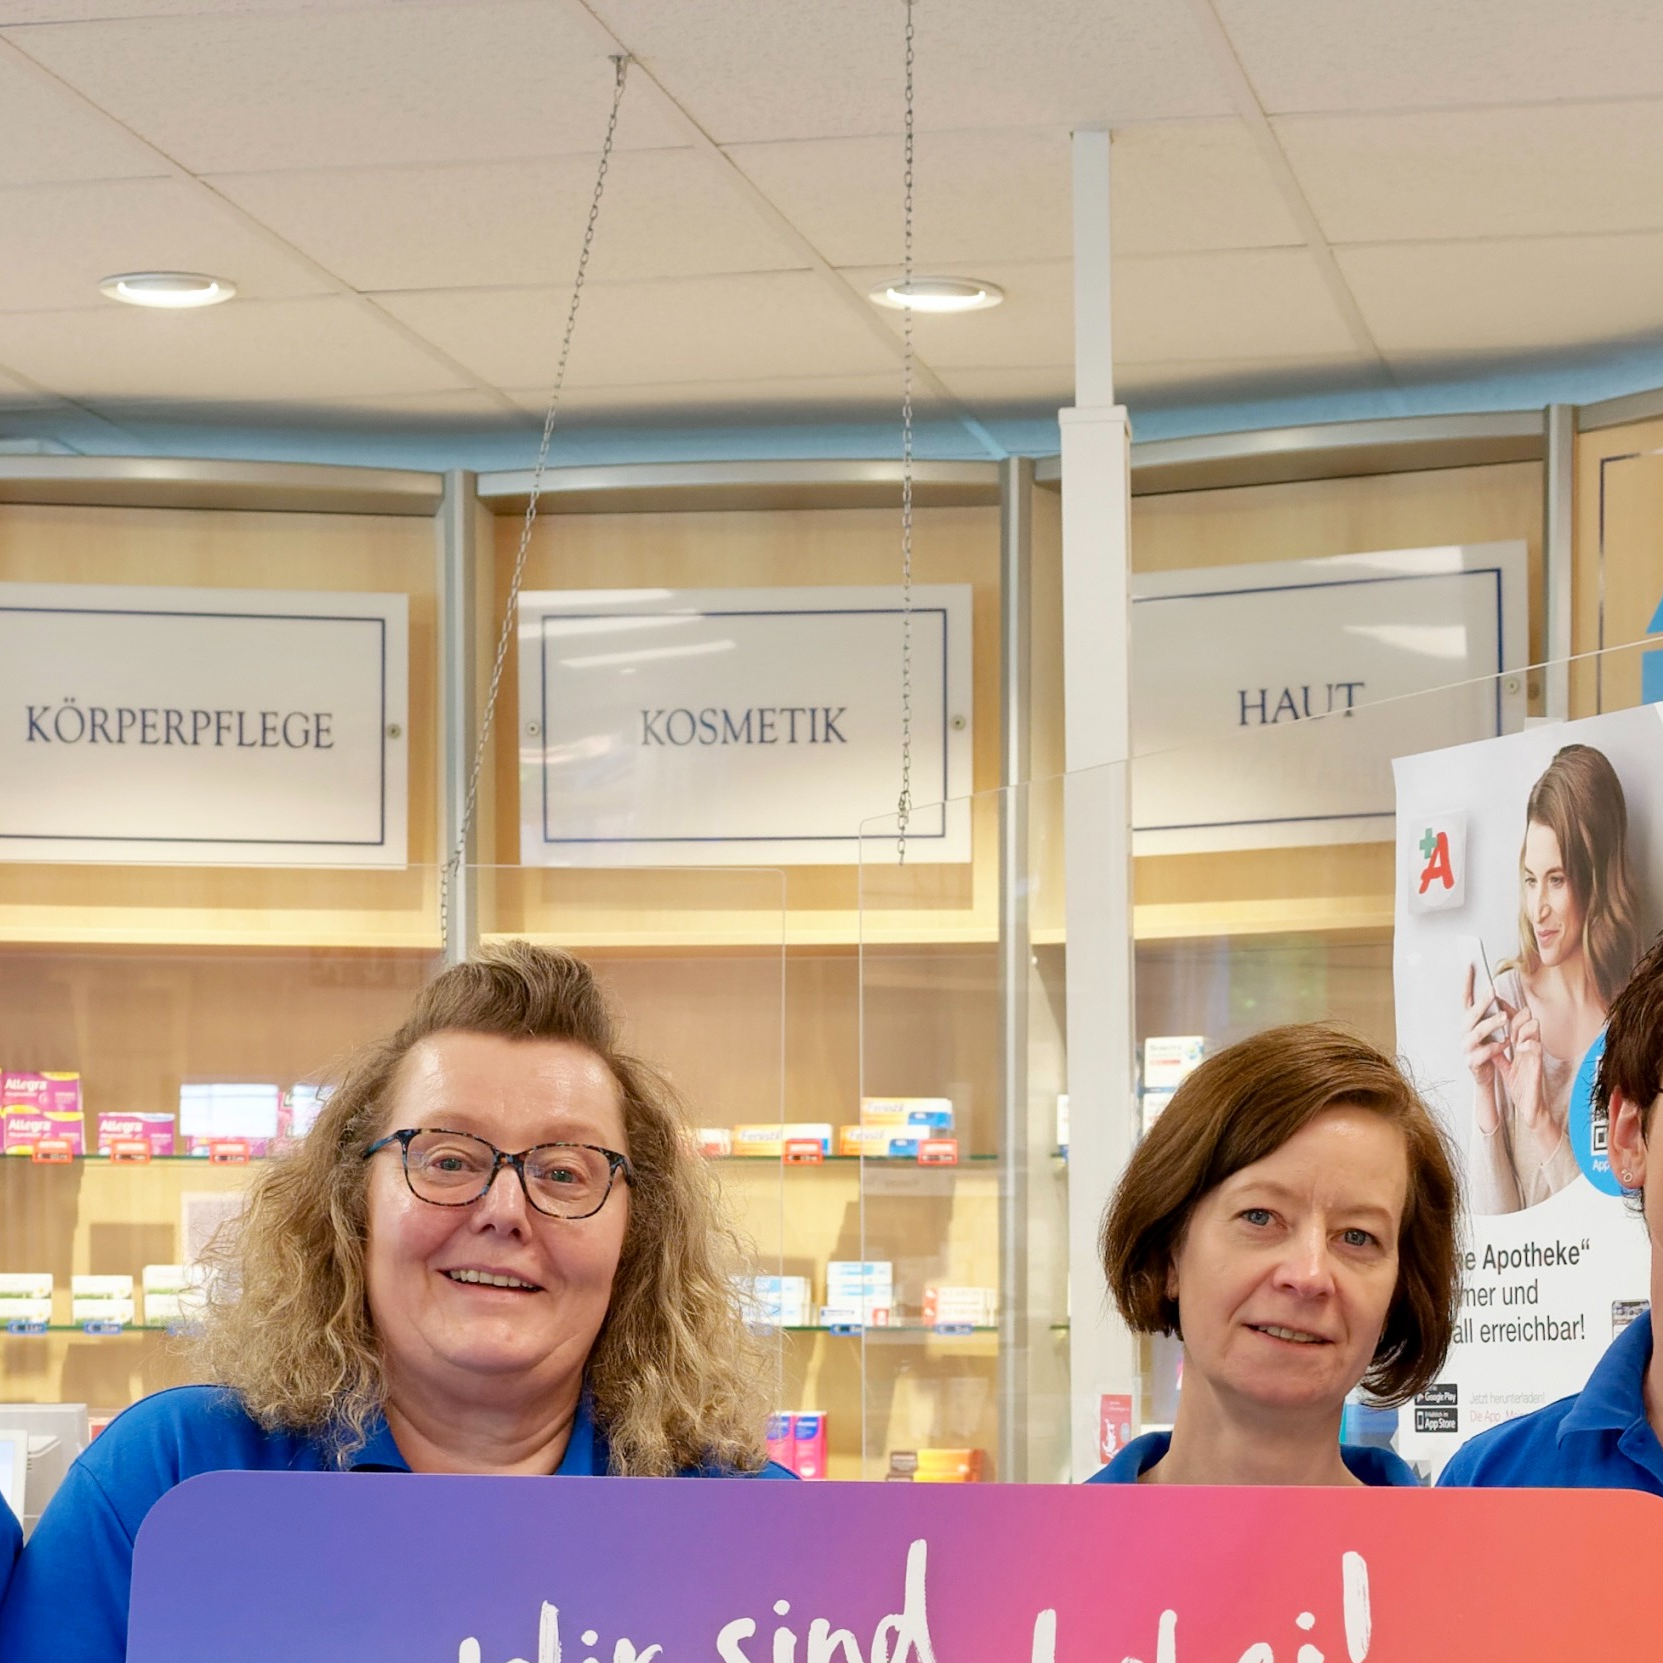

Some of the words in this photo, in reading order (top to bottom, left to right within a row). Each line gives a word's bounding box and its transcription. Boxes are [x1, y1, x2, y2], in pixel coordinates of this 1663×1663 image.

[25, 697, 335, 751] KÖRPERPFLEGE
[1238, 681, 1366, 728] HAUT
[640, 706, 848, 747] KOSMETIK
[1502, 1278, 1540, 1305] und
[1480, 1313, 1586, 1344] erreichbar!
